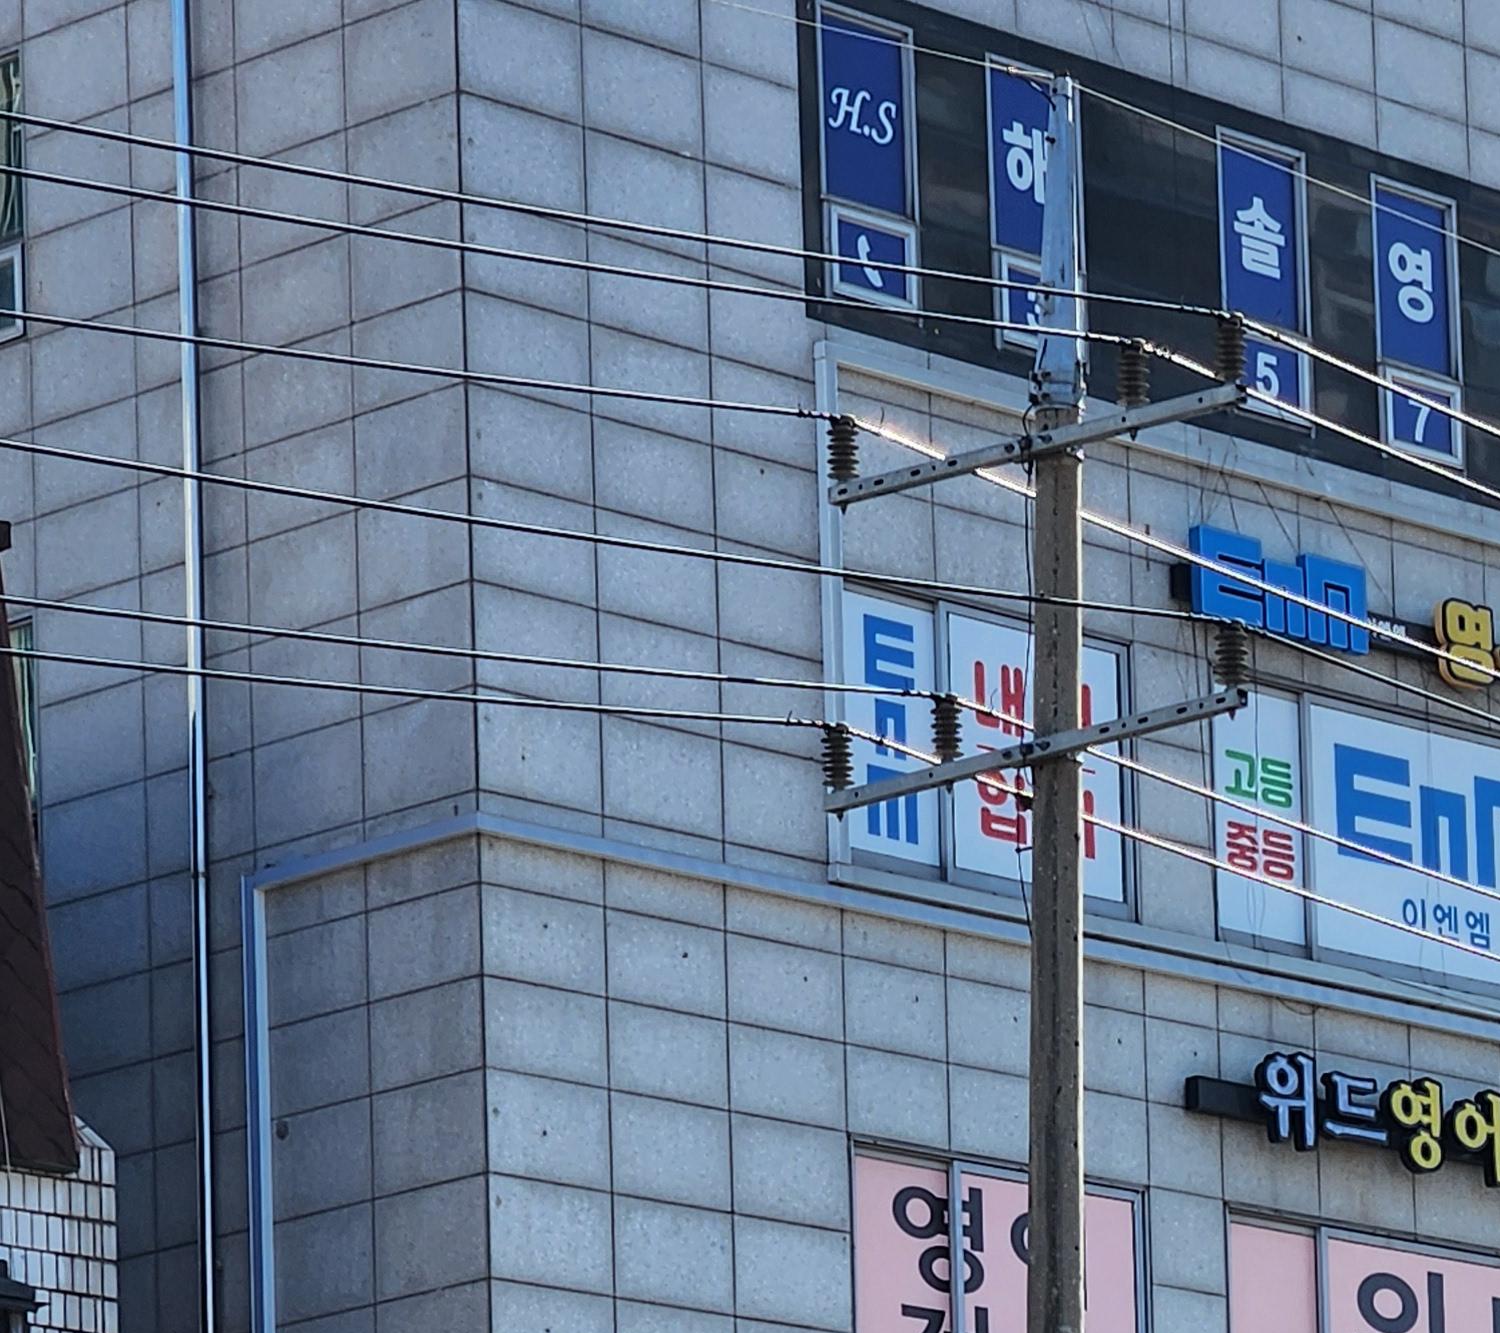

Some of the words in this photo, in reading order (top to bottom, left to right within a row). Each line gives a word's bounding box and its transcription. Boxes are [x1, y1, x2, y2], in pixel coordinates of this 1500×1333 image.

[1224, 749, 1293, 810] 고등
[1226, 820, 1295, 882] 중등
[1401, 896, 1491, 951] 이엔엠
